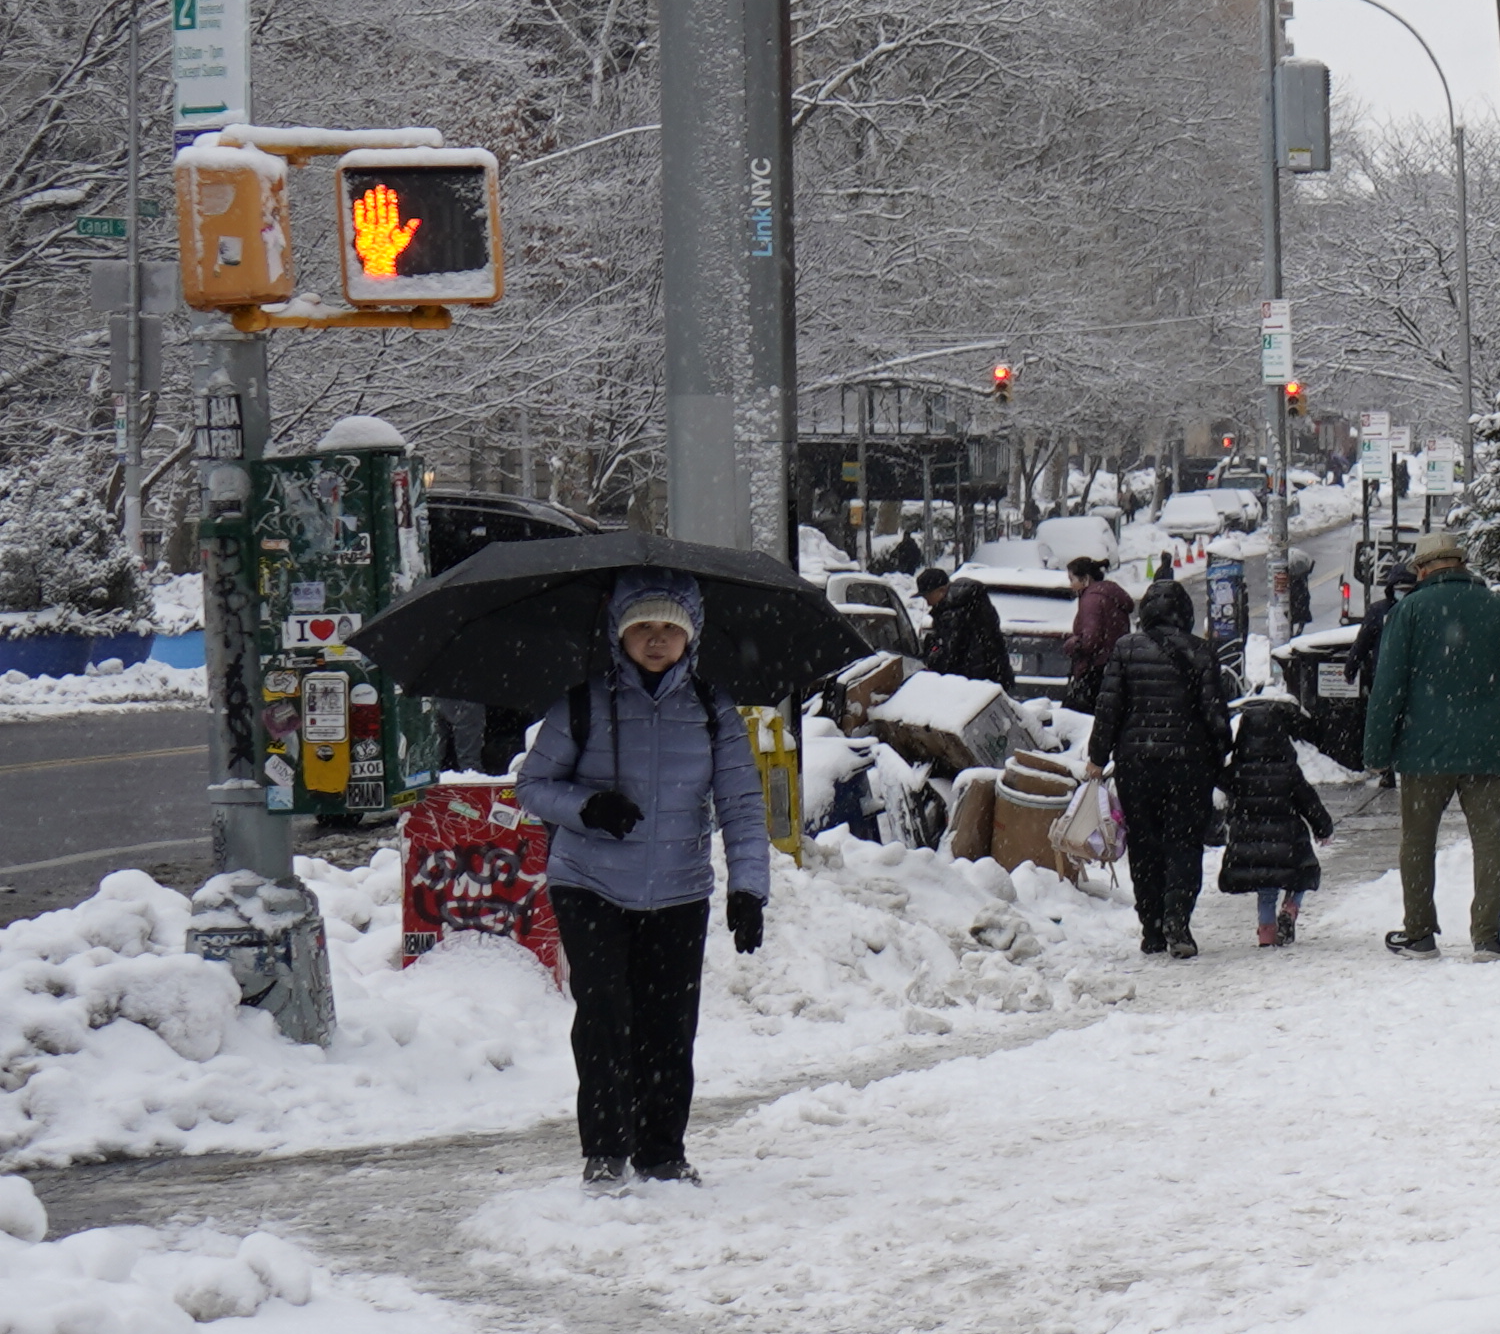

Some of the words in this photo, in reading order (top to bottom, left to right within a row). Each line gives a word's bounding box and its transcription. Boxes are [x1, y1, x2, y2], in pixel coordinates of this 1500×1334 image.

[750, 157, 773, 257] LinkNYC
[79, 218, 114, 234] Canal
[296, 620, 310, 642] I
